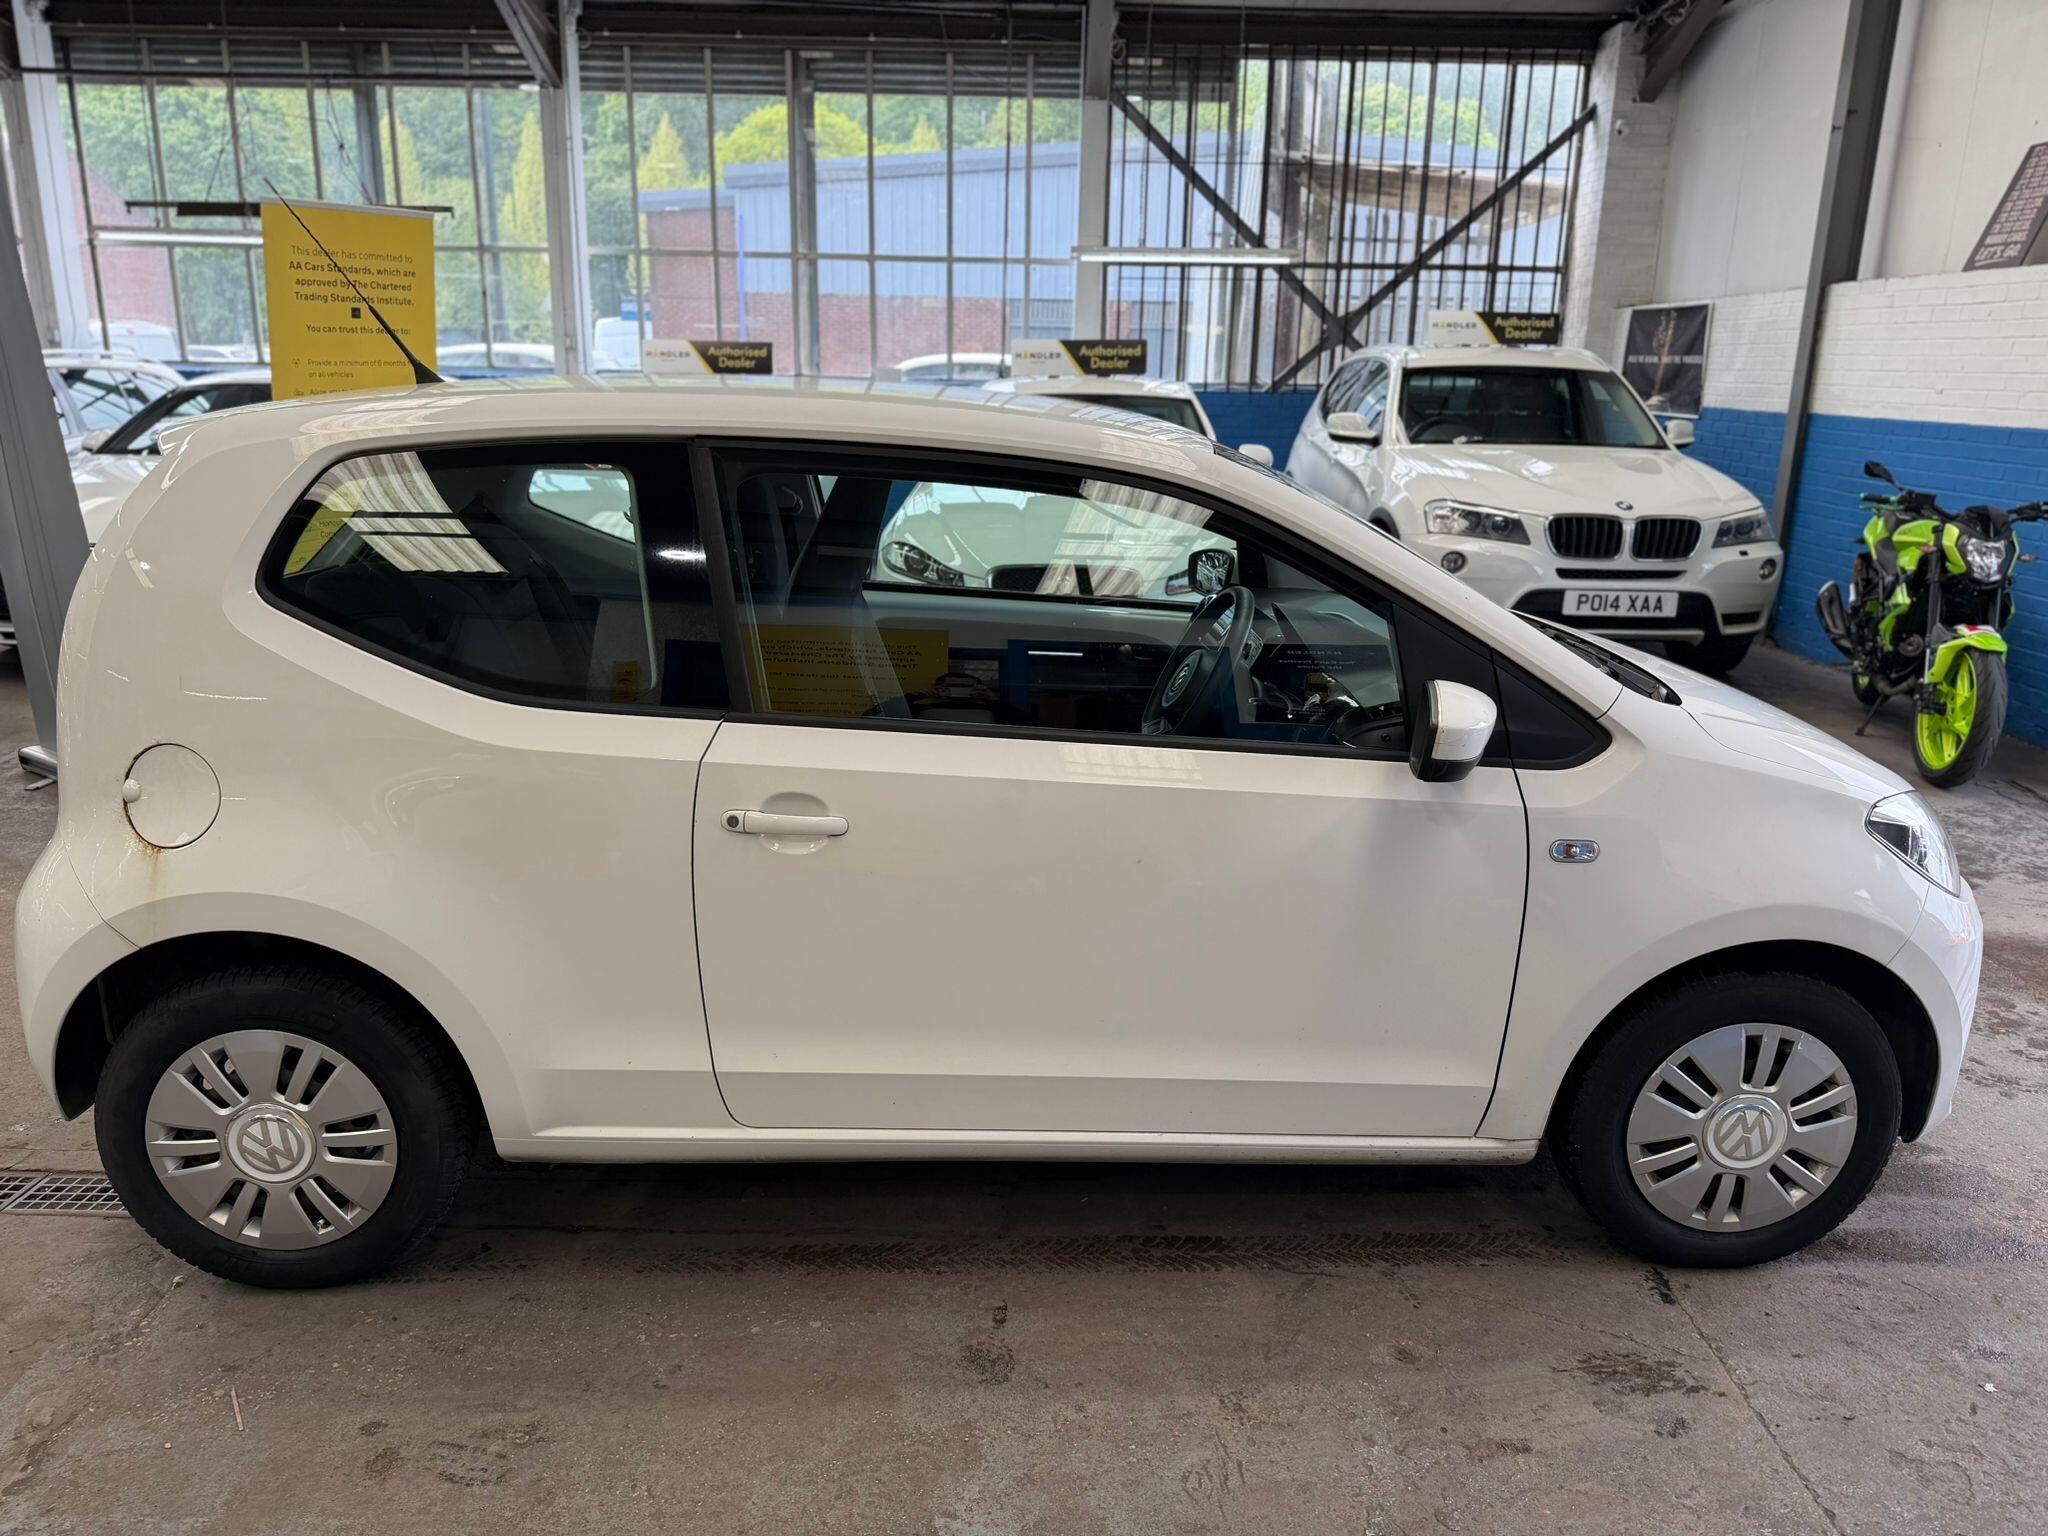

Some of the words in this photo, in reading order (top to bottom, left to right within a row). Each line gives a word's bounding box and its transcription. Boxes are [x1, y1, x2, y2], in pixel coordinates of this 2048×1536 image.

[291, 245, 310, 256] This
[341, 249, 358, 259] has
[358, 251, 403, 263] committed
[404, 254, 413, 263] to
[289, 260, 303, 271] AA
[304, 261, 326, 272] Cars
[376, 267, 401, 277] which
[402, 270, 417, 279] are
[295, 278, 338, 288] approved
[340, 278, 351, 290] by
[352, 280, 369, 290] The
[370, 281, 412, 292] Chartered
[294, 291, 328, 304] Trading
[330, 293, 376, 304] Standards
[376, 296, 415, 306] Institute.
[1494, 316, 1555, 328] Authorised
[306, 324, 321, 333] You
[322, 325, 337, 334] can
[338, 326, 358, 334] trust
[359, 327, 374, 335] this
[375, 327, 400, 335] deer
[1505, 328, 1543, 339] Dealer
[707, 346, 768, 358] Authorised
[1079, 345, 1142, 357] Authorised
[307, 359, 332, 367] Provide
[339, 360, 369, 368] minimum
[383, 360, 407, 368] months
[718, 357, 757, 368] Dealer
[1090, 357, 1130, 369] Dealer
[326, 370, 354, 378] vehicles
[1576, 593, 1621, 612] PO14
[1626, 594, 1663, 613] XAA
